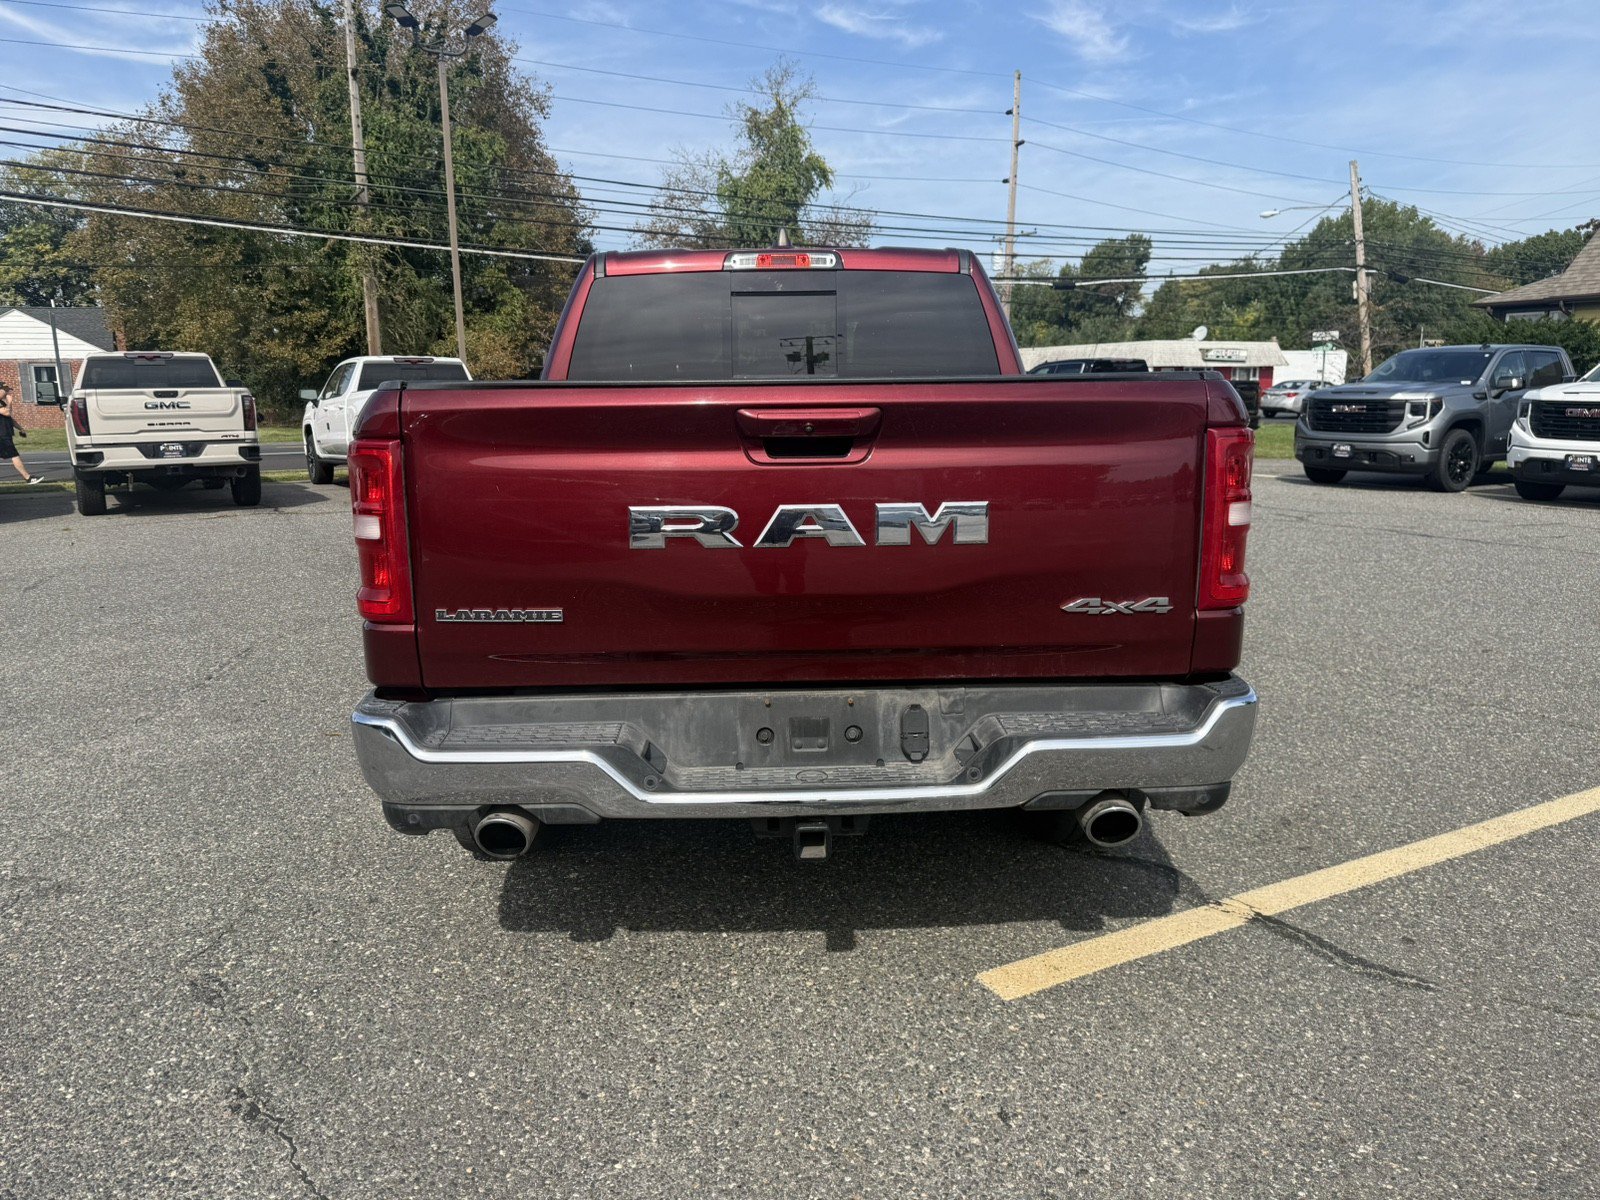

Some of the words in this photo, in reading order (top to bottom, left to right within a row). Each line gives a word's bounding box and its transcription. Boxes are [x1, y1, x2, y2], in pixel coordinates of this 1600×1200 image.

[144, 401, 191, 410] GMC
[1565, 408, 1600, 417] GM
[628, 501, 990, 549] RAM
[1060, 597, 1174, 614] 4x4
[435, 608, 564, 622] LARAMIE
